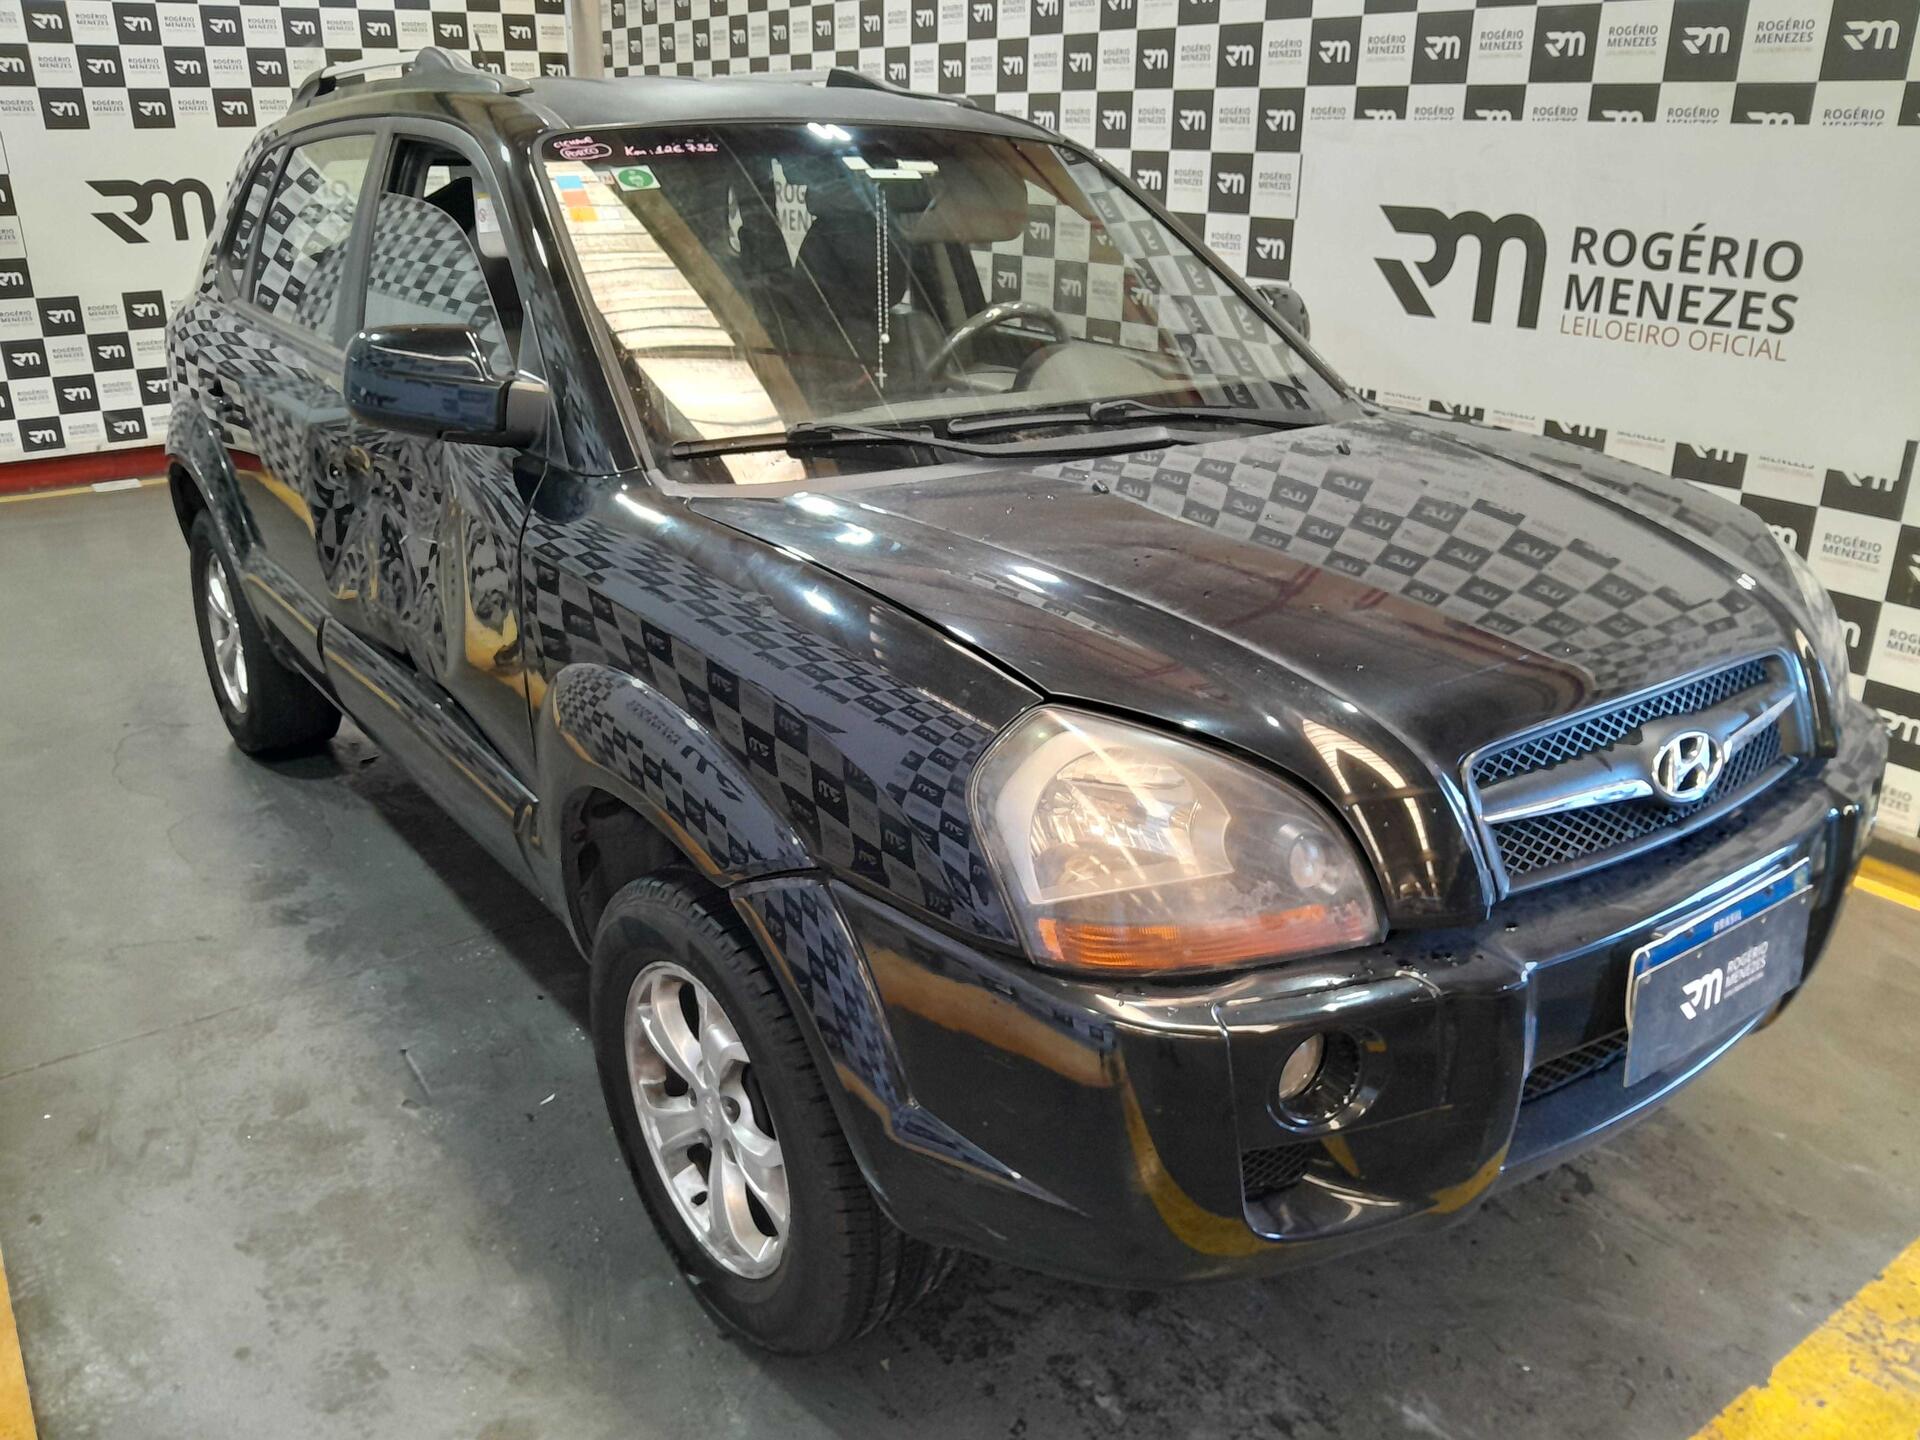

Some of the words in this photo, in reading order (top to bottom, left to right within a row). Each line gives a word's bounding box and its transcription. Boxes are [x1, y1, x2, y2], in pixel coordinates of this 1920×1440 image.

[1609, 24, 1658, 36] ROGÉRIO
[1757, 17, 1815, 31] ROGÉRIO
[1481, 28, 1524, 40] ROGÉRIO
[1755, 31, 1813, 44] MENEZES
[1480, 40, 1523, 51] MENEZES
[1607, 37, 1657, 48] MENEZES
[1668, 106, 1720, 118] ROGÉRIO
[1824, 106, 1885, 120] ROGÉRIO
[1570, 222, 1804, 283] ROGÉRIO
[1564, 273, 1800, 335] MENEZES
[1560, 314, 1680, 348] LEILOEIRO
[1687, 330, 1788, 362] OFICIAL
